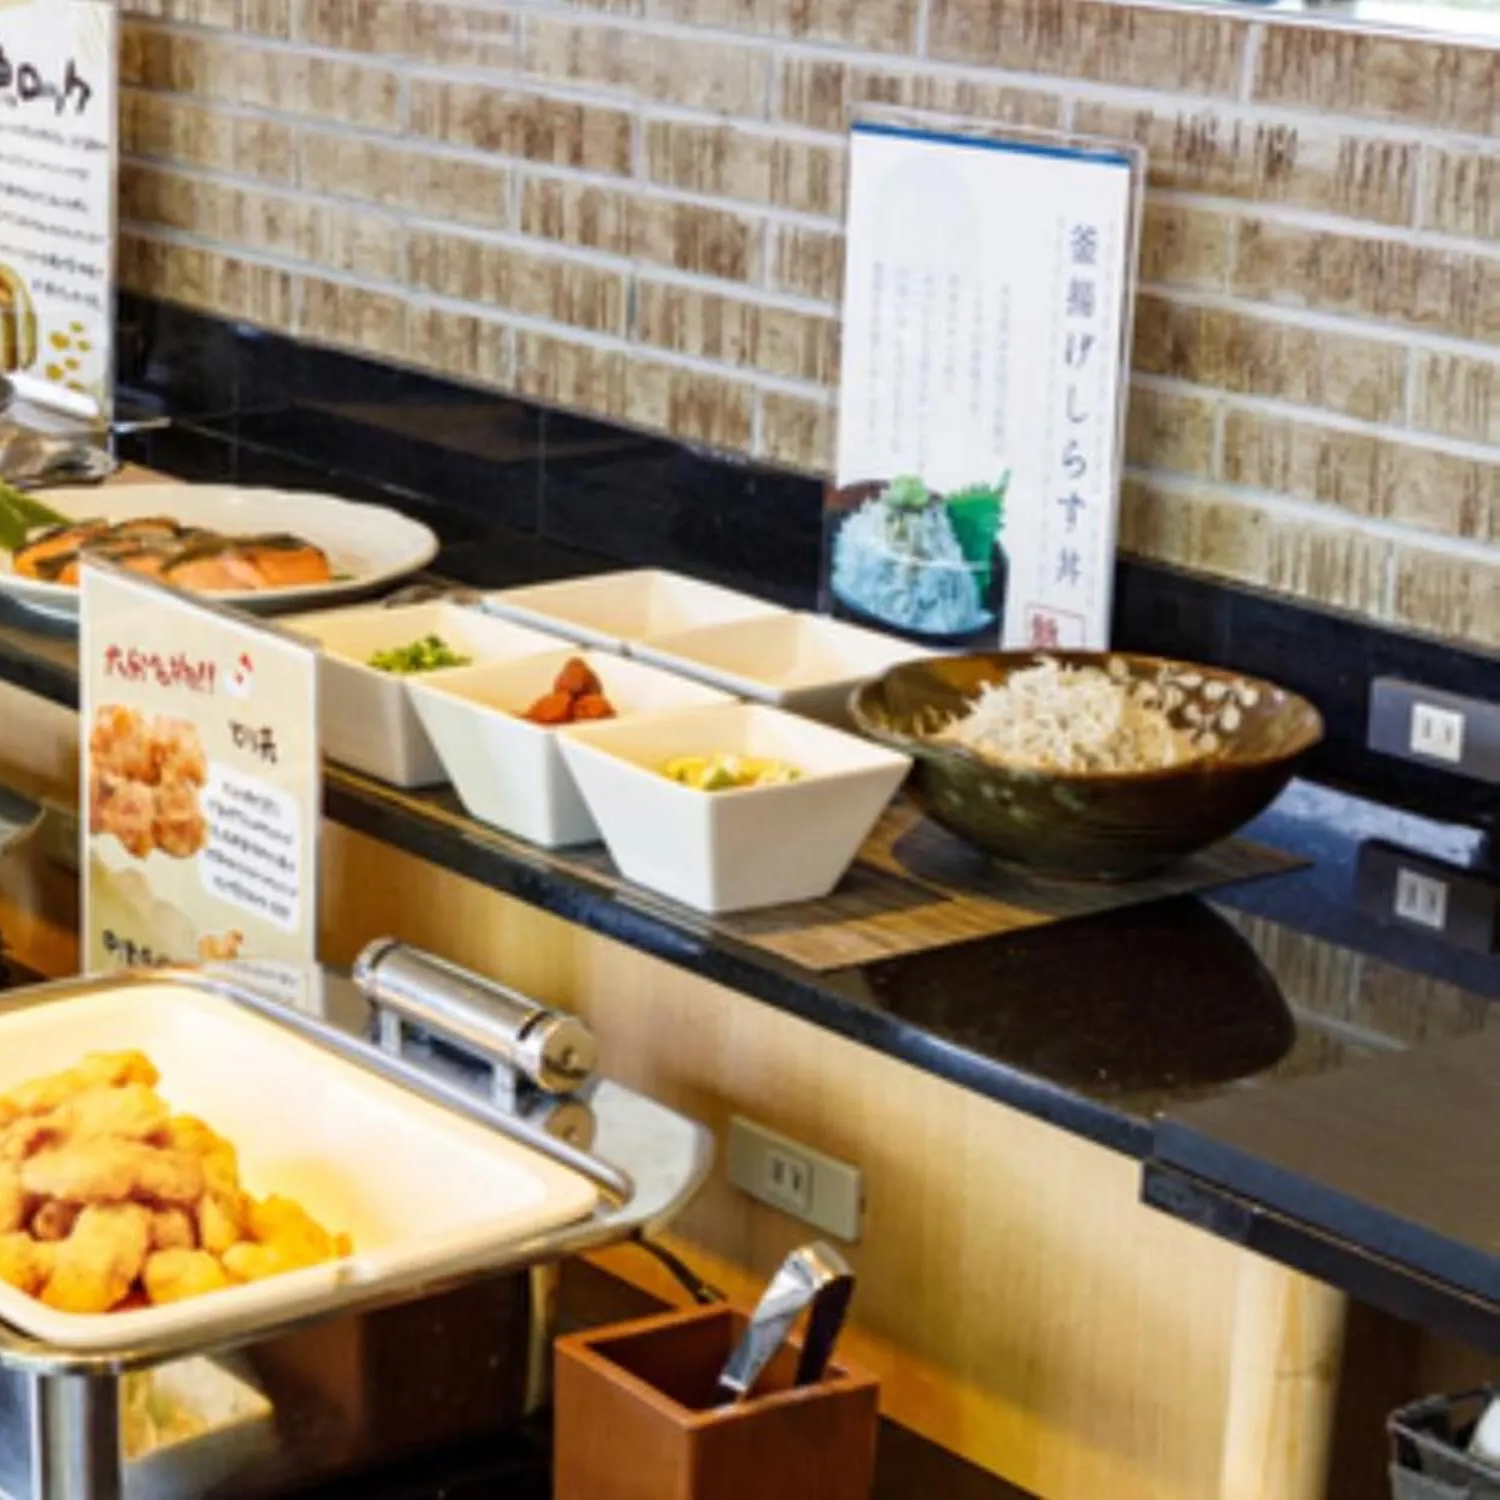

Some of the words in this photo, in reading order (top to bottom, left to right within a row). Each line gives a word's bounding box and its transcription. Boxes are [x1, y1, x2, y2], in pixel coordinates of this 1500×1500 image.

[1056, 223, 1099, 584] 釜揚げしらす丼
